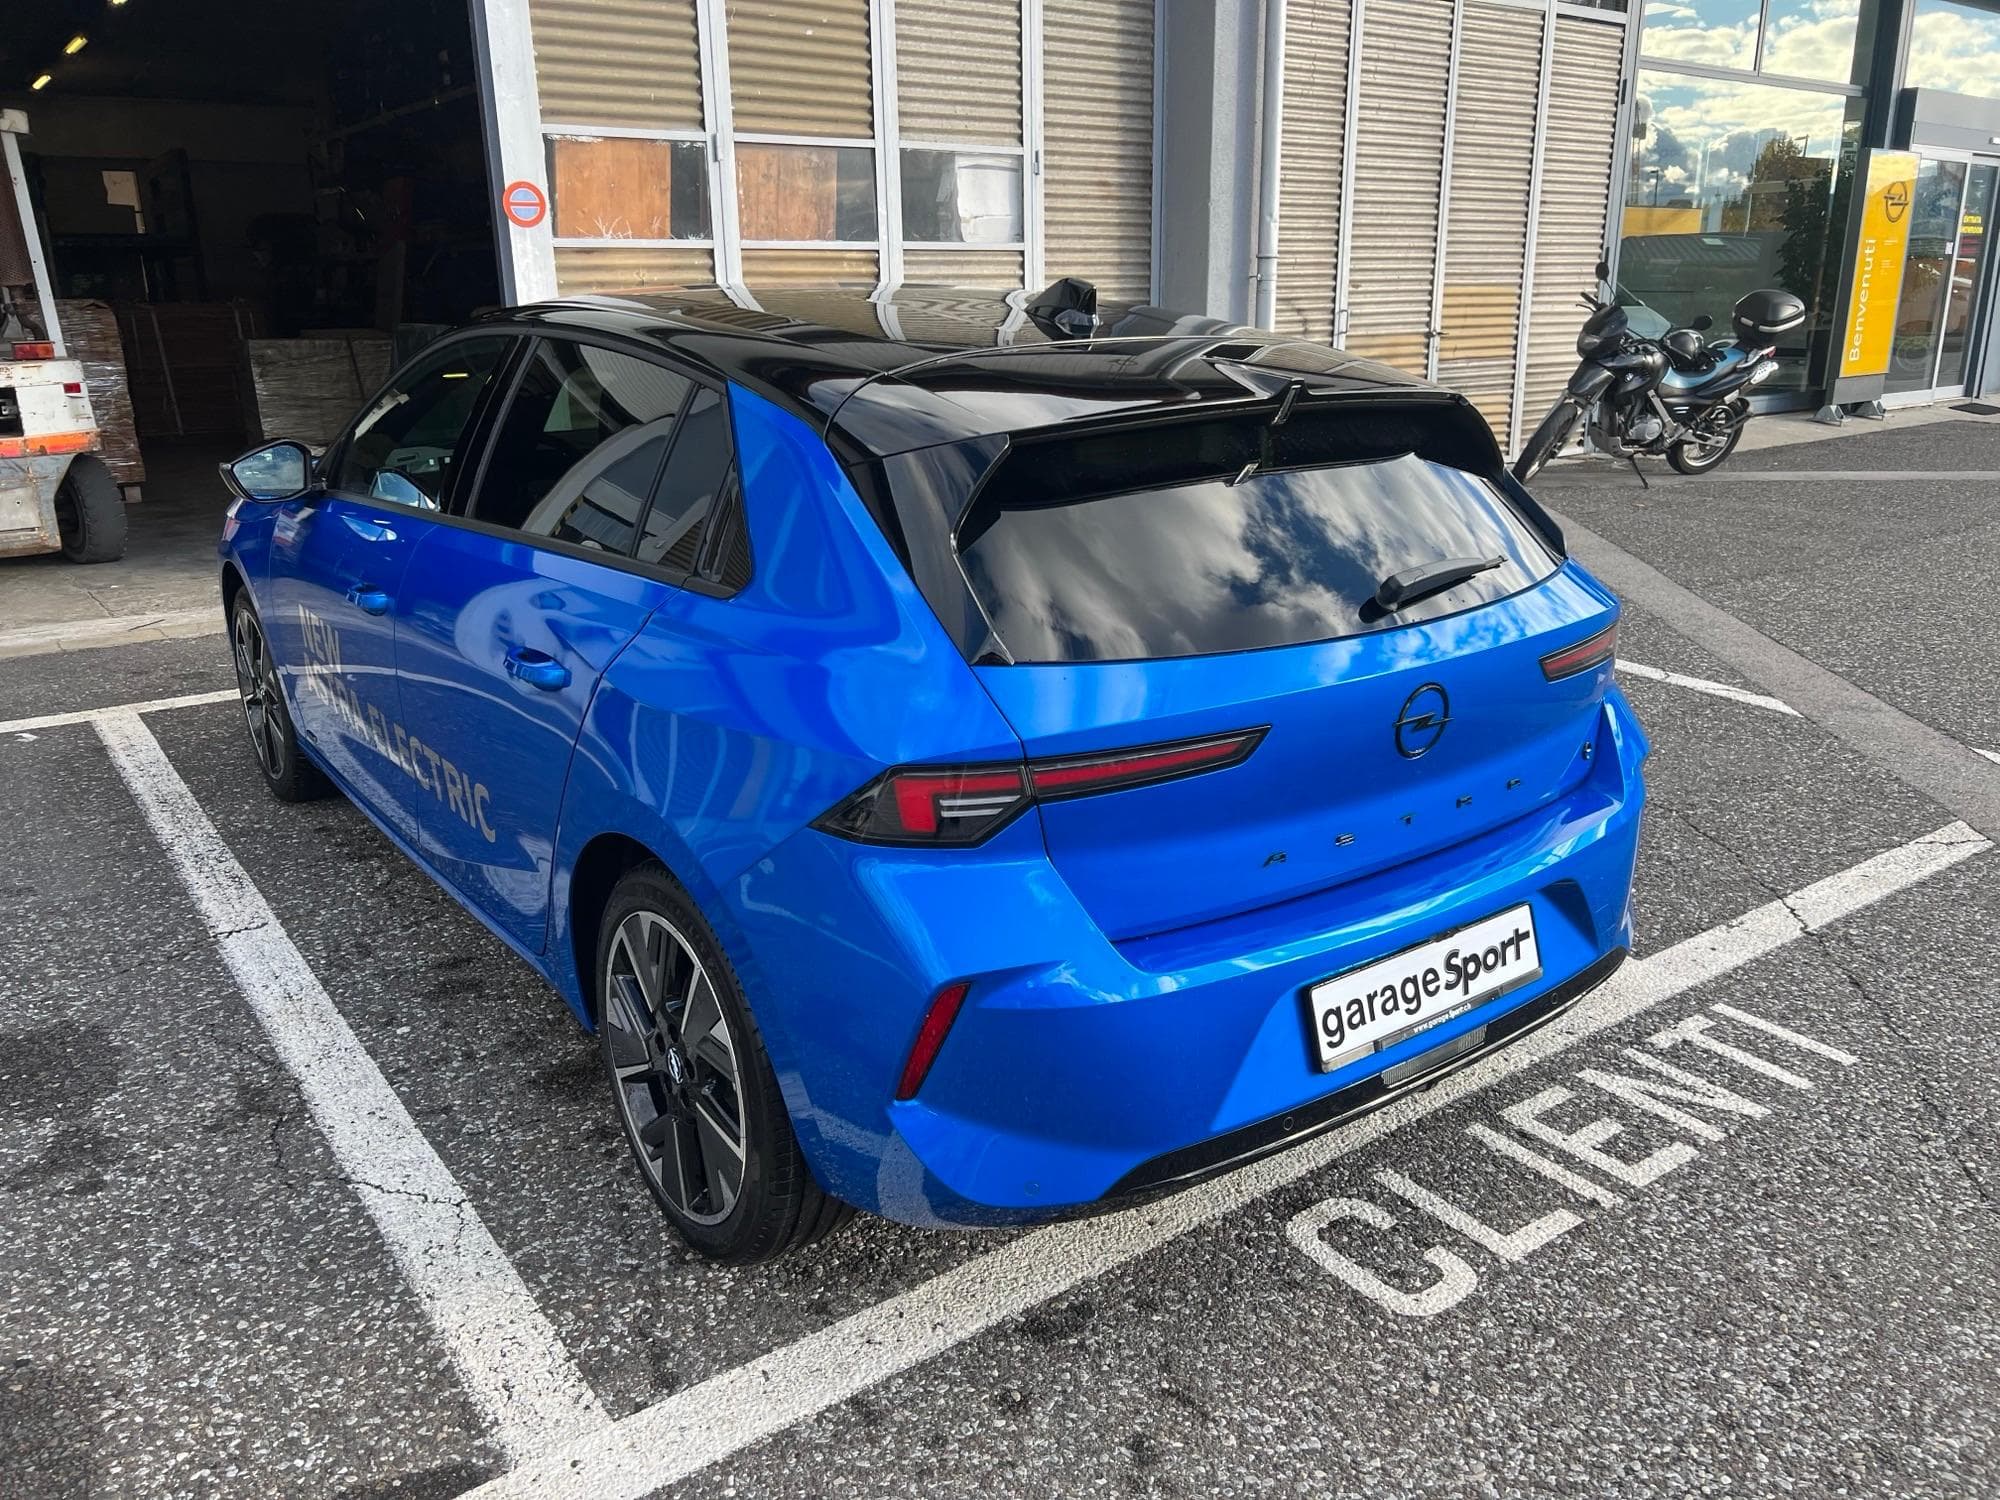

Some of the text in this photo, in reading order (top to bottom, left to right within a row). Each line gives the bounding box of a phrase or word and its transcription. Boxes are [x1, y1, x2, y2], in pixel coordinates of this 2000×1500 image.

[1849, 239, 1877, 361] Benvenuti
[298, 603, 342, 675] NEW
[367, 702, 496, 843] ELECTRIC
[1286, 1003, 1859, 1317] CLIENTI
